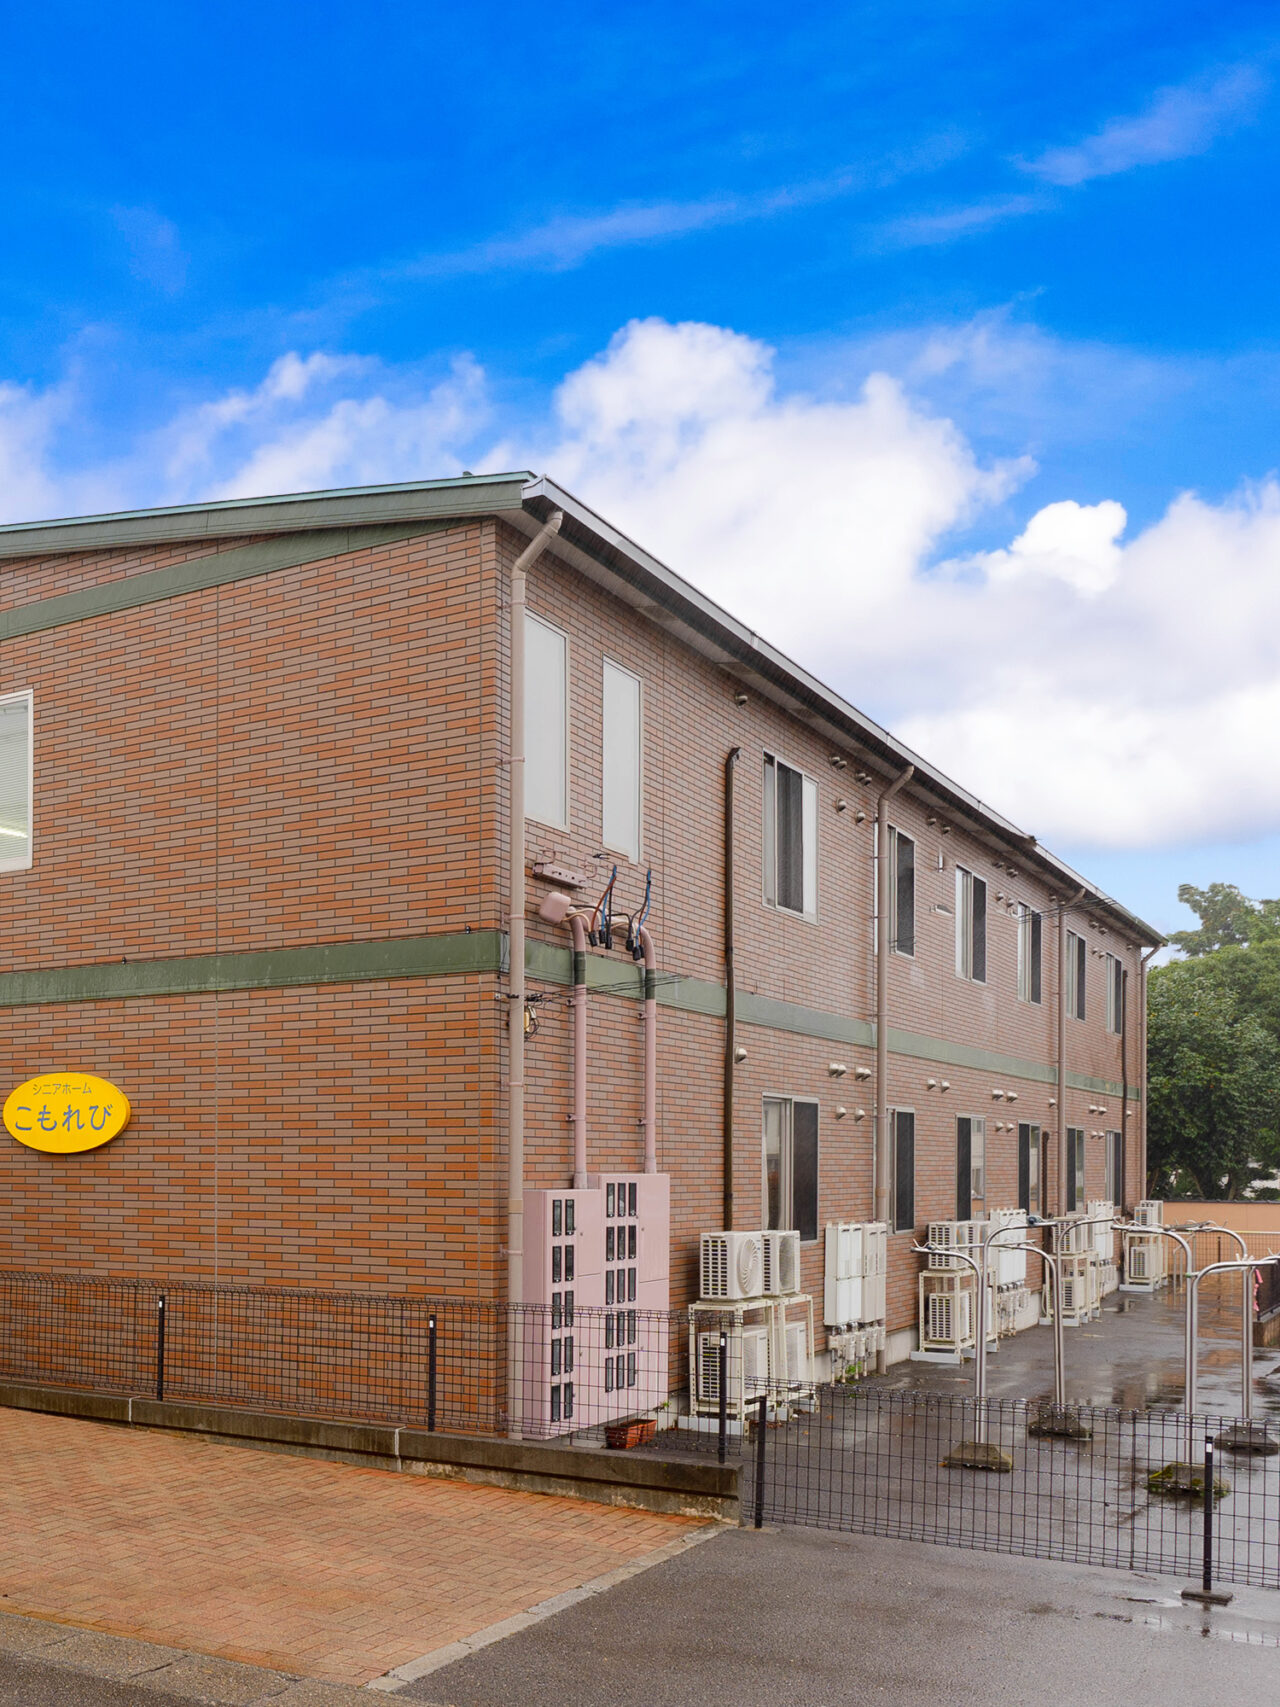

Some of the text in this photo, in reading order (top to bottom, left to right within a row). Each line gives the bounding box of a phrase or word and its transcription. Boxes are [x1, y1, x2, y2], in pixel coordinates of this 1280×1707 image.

[33, 1082, 92, 1095] シニアホーム
[15, 1104, 113, 1132] こもれび
